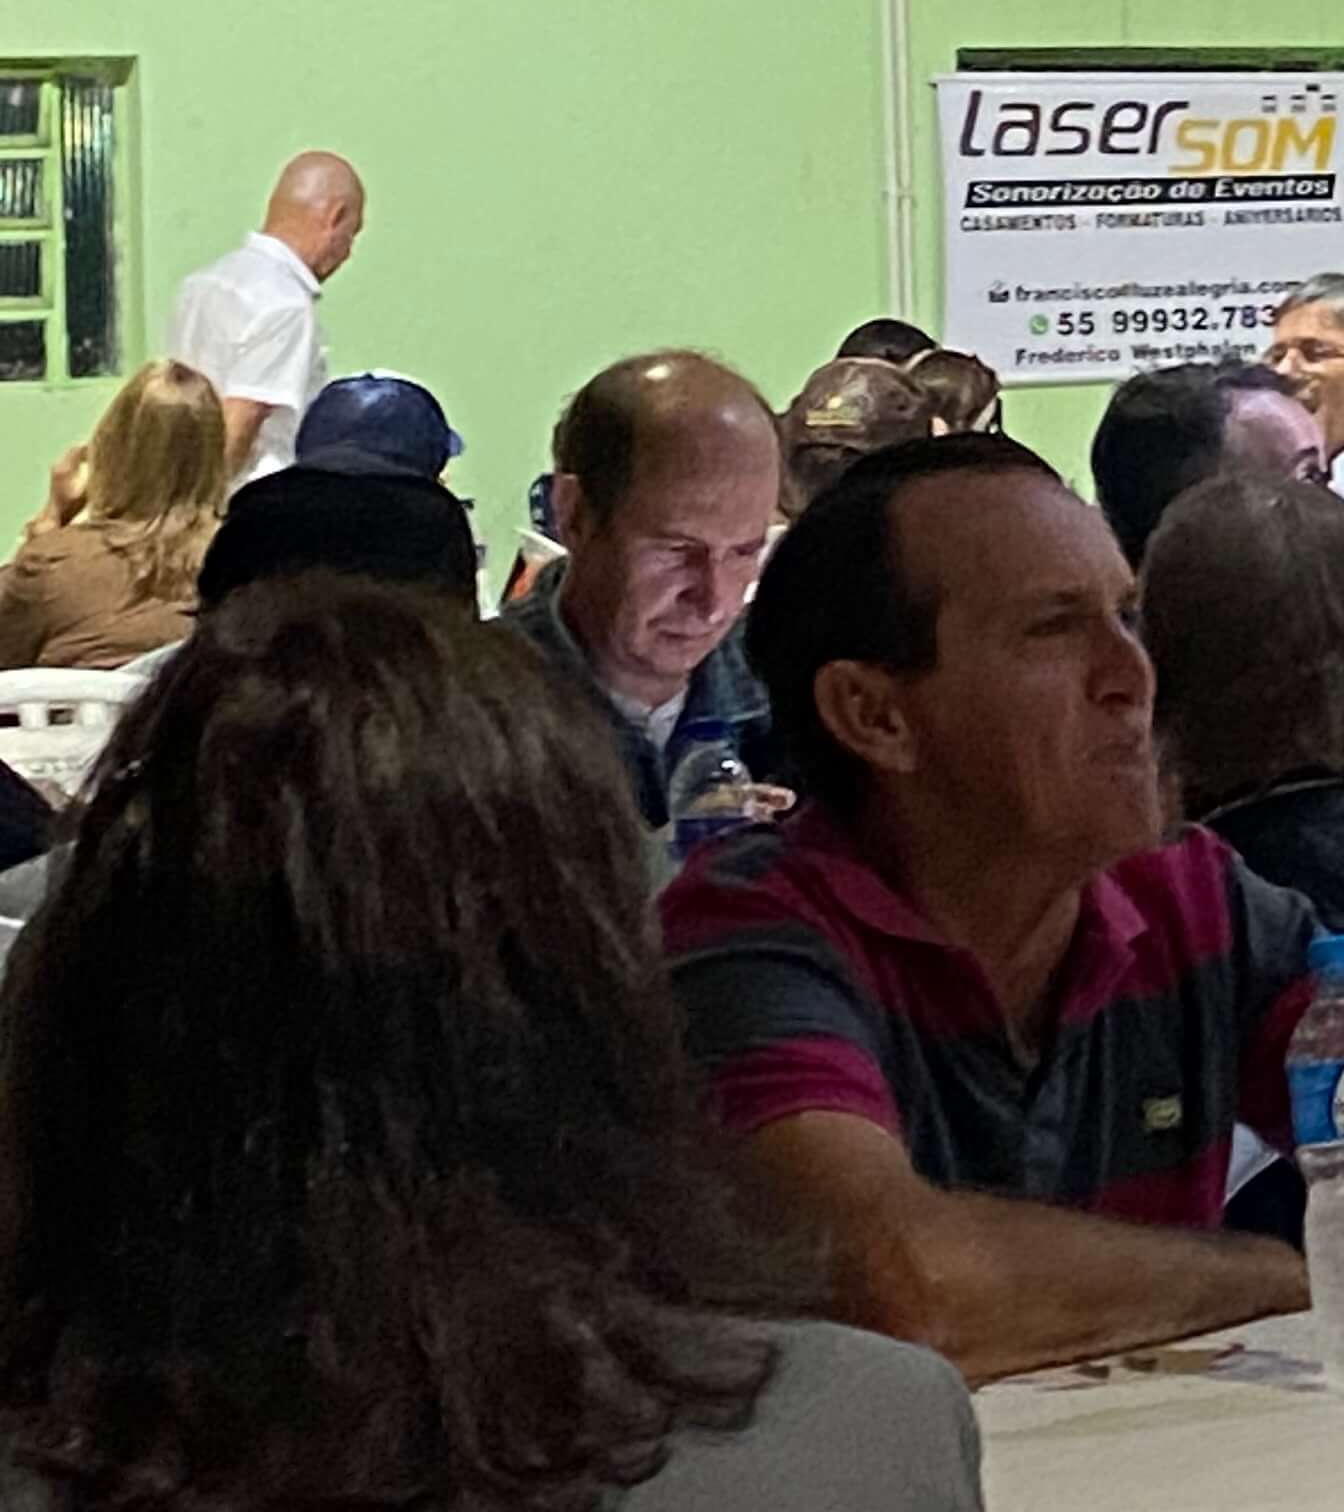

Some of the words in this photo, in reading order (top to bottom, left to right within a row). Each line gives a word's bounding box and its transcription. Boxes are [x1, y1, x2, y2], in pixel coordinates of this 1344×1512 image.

[970, 182, 1161, 204] Sonorização
[1168, 181, 1207, 200] de
[1213, 177, 1331, 199] Eventos
[959, 212, 1077, 232] CASAMENTOS
[1095, 210, 1205, 229] FORMATURAS
[1056, 311, 1096, 336] 55
[1111, 304, 1279, 334] 99932.783
[1015, 346, 1121, 366] Frederico
